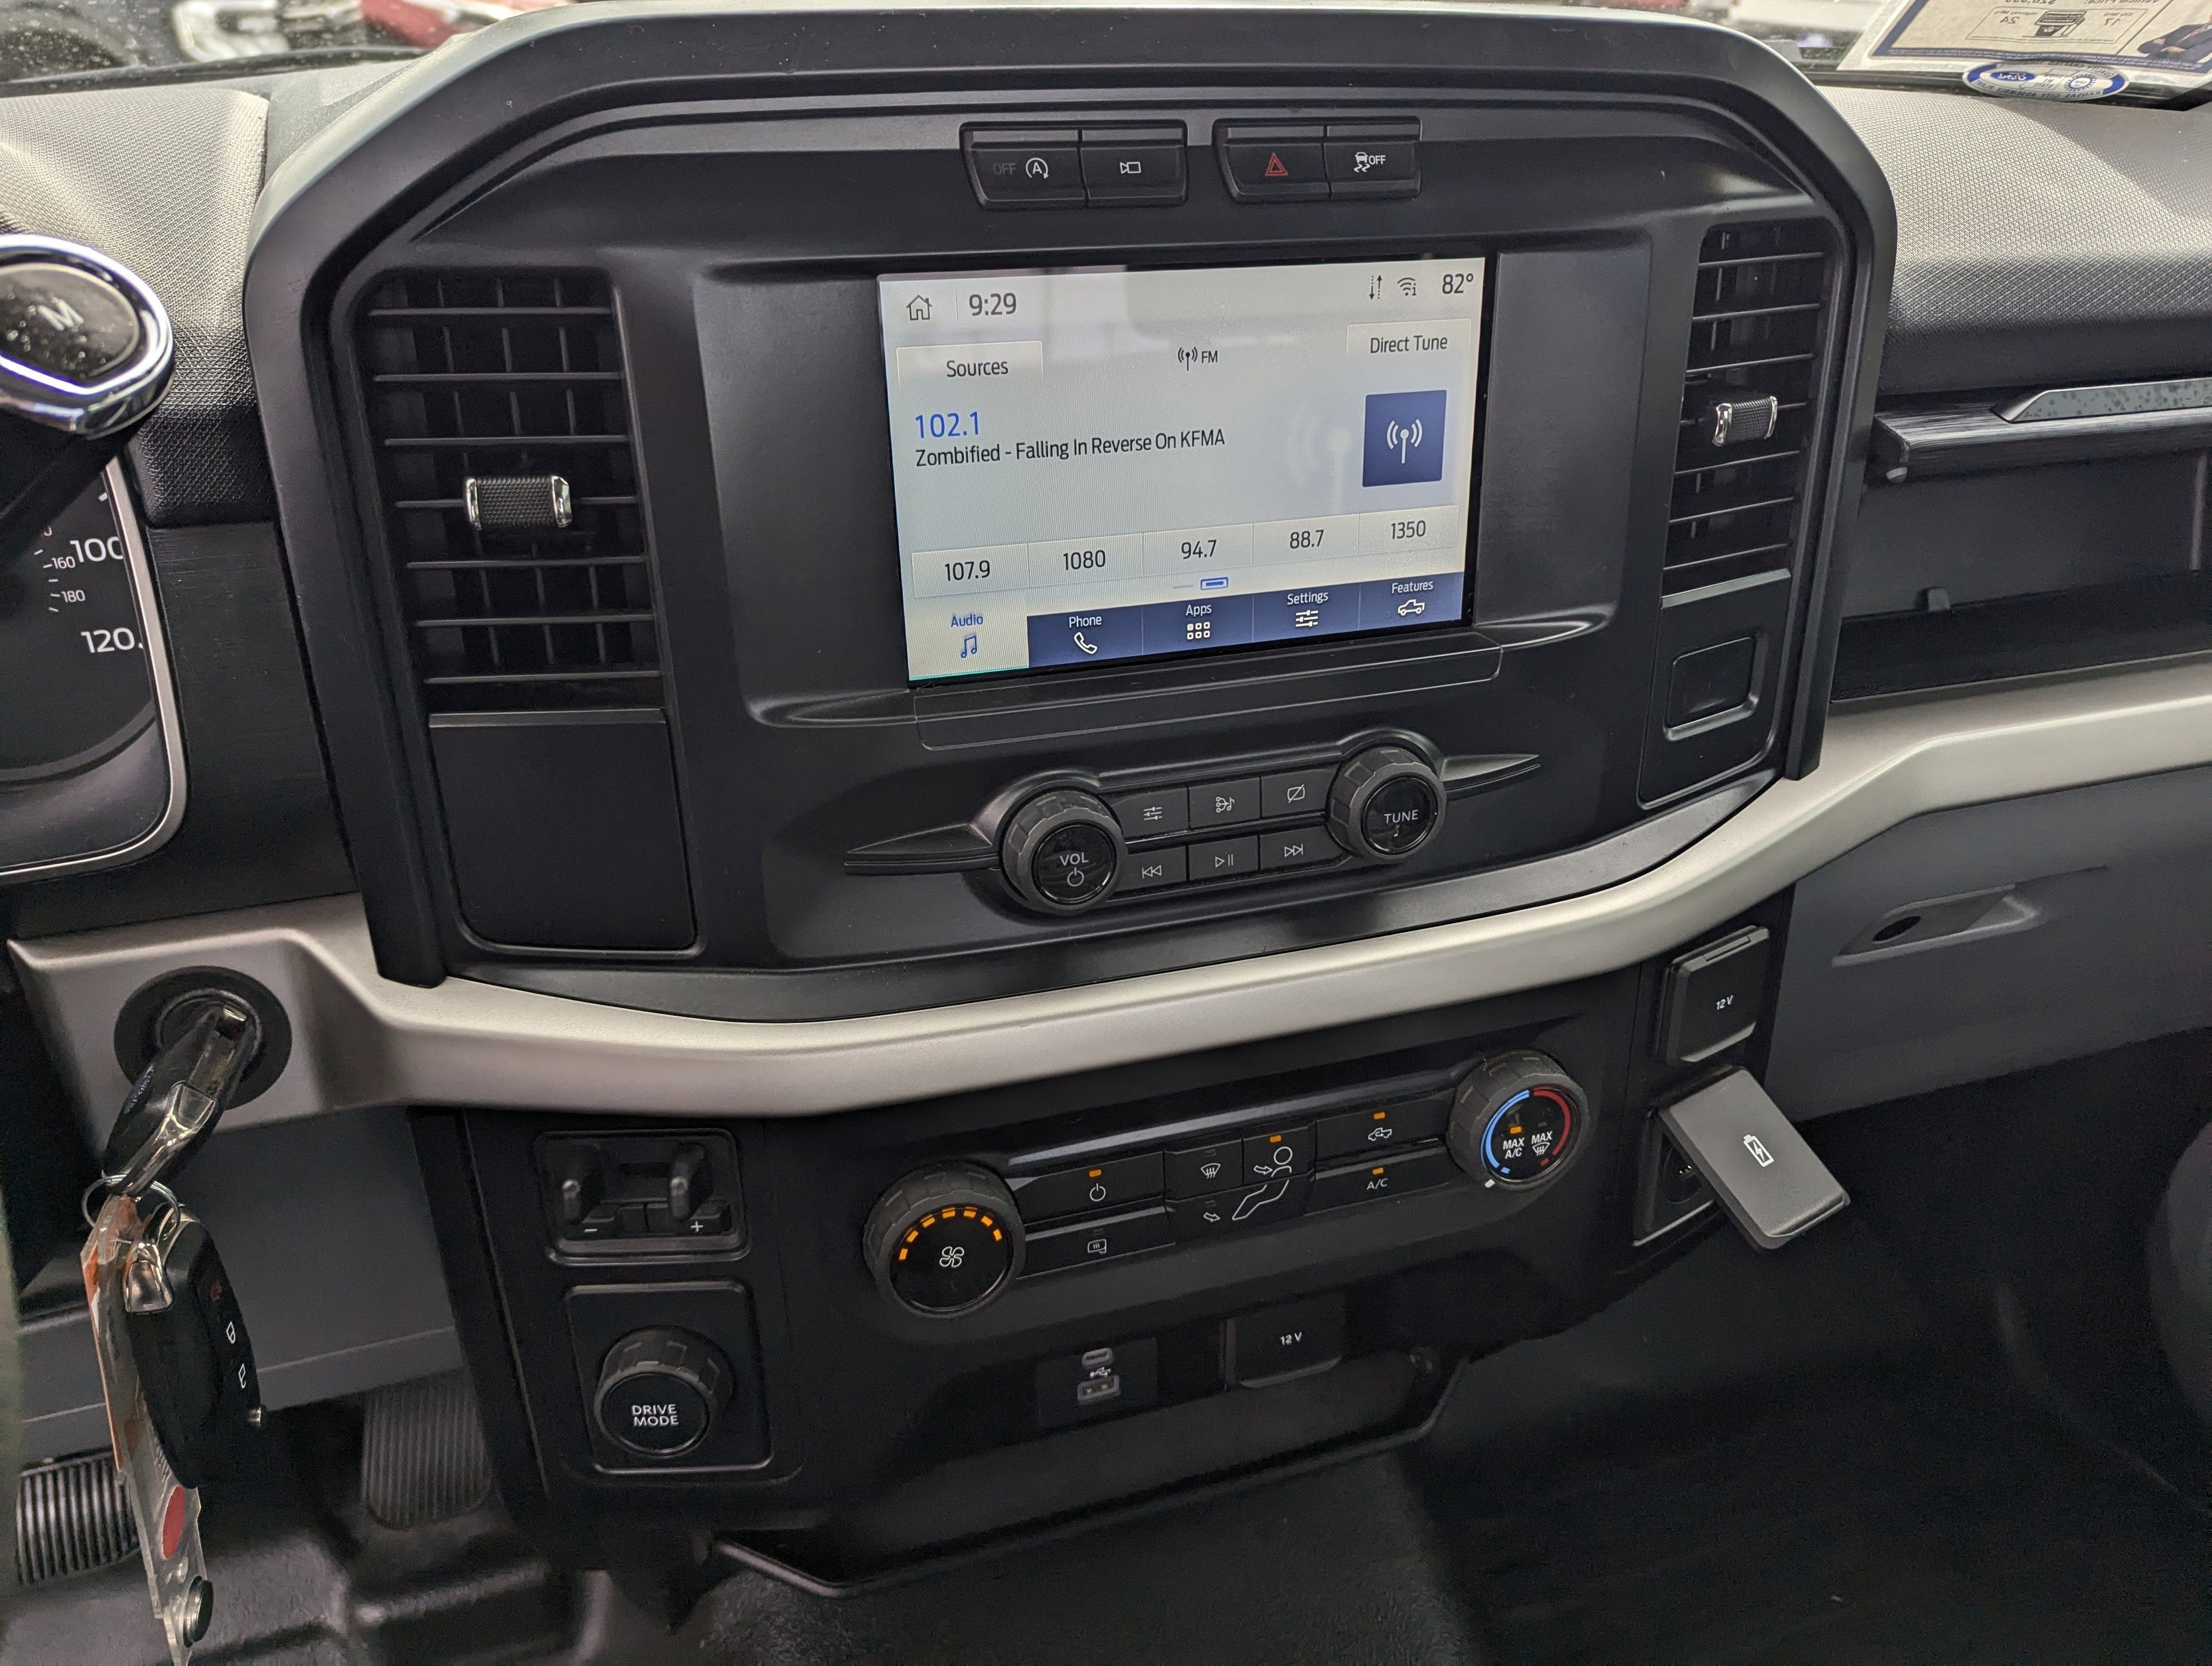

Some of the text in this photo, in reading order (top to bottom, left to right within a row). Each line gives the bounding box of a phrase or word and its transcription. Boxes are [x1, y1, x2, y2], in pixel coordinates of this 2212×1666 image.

[1367, 154, 1386, 166] OFF
[993, 163, 1017, 176] OFF
[1442, 273, 1474, 295] 82°
[968, 292, 1017, 317] 9:29
[1370, 334, 1448, 354] Direct Tune
[1201, 350, 1218, 364] FM
[946, 359, 1008, 378] Sources
[915, 411, 980, 439] 102.1
[915, 444, 1001, 467] Zombified
[1015, 440, 1069, 460] Falling
[1073, 439, 1088, 456] In
[1091, 435, 1152, 455] Reverse
[1155, 433, 1177, 450] On
[1180, 429, 1226, 447] KFMA
[1390, 520, 1426, 540] 1350
[1289, 529, 1324, 549] 88.7
[1180, 539, 1217, 560] 94.7
[52, 556, 76, 570] 160
[1063, 549, 1107, 571] 1080
[944, 560, 991, 581] 107.9
[1391, 580, 1434, 595] Features
[61, 589, 86, 603] 180
[1287, 589, 1329, 606] Settings
[1185, 603, 1212, 617] Apps
[950, 613, 984, 628] Audio
[1069, 614, 1102, 629] Phone
[81, 627, 136, 654] 120
[1384, 809, 1419, 824] TUNE
[1059, 853, 1089, 867] VOL
[1502, 1137, 1525, 1150] MAX
[1531, 1131, 1553, 1144] MAX
[1504, 1147, 1523, 1159] A/C
[1366, 1177, 1389, 1191] A/C
[632, 1404, 677, 1415] DRIVE
[633, 1415, 679, 1426] MODE
